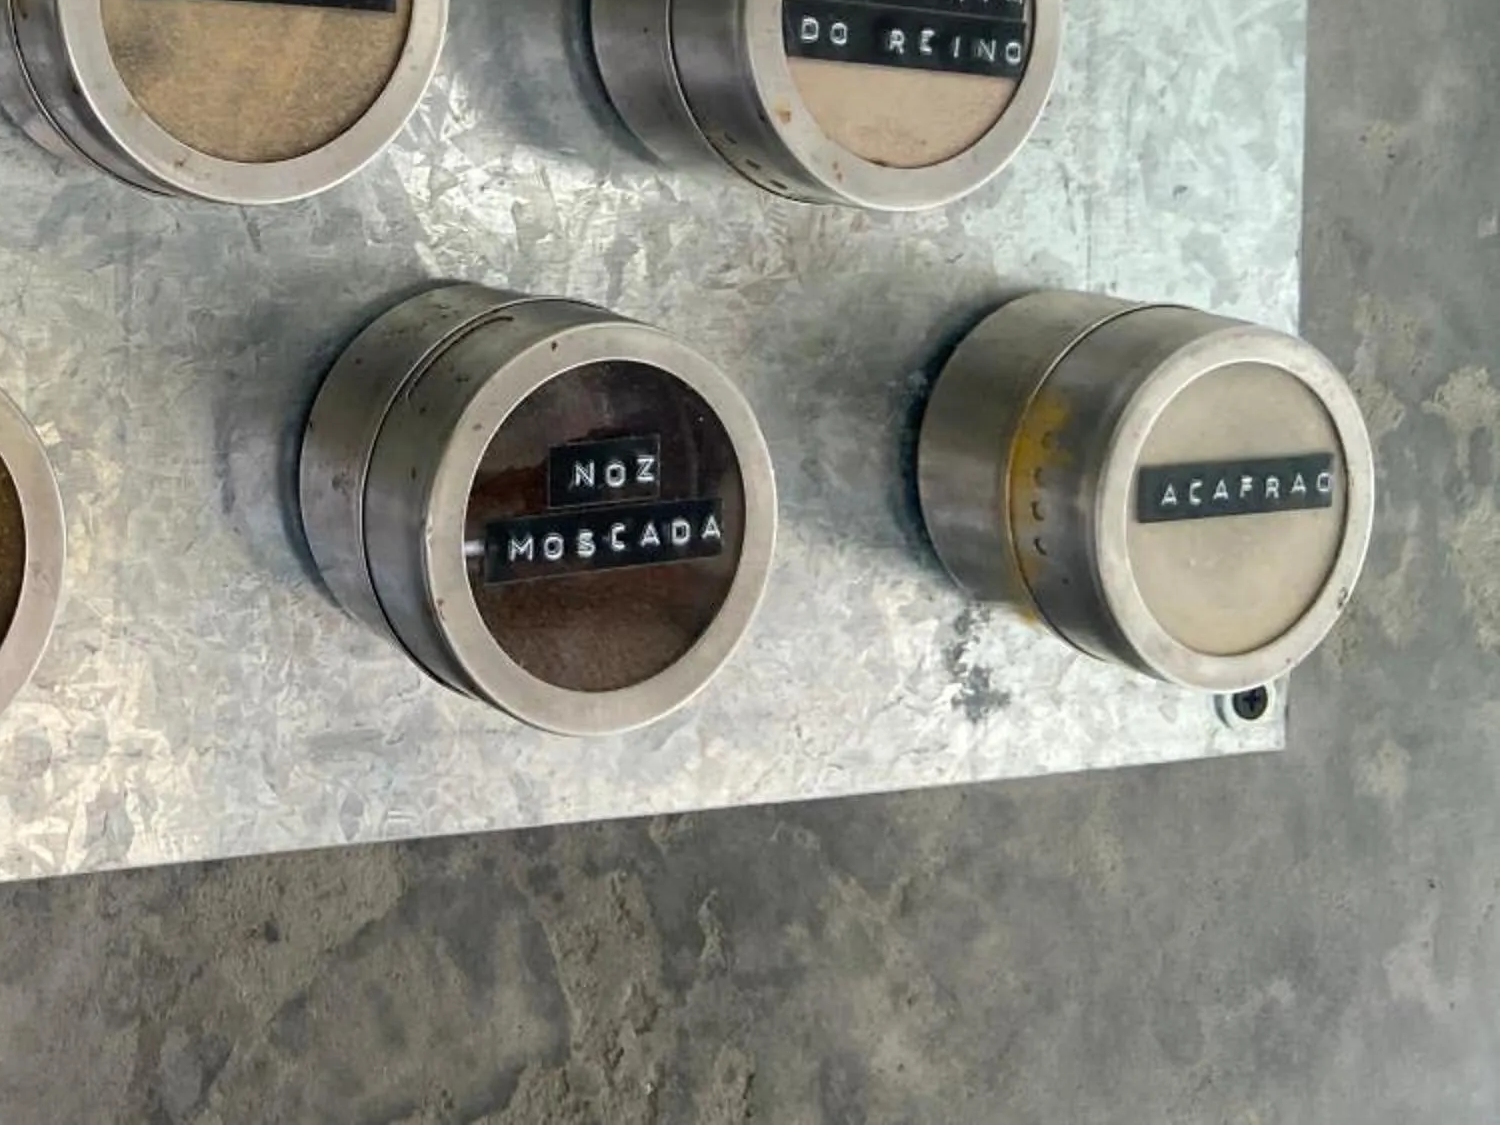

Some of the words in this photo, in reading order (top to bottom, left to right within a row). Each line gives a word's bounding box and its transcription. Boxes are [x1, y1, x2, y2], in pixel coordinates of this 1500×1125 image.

[800, 17, 848, 45] DO
[887, 28, 1023, 65] REINO
[570, 454, 656, 490] NOZ
[508, 514, 721, 562] MOSCADA
